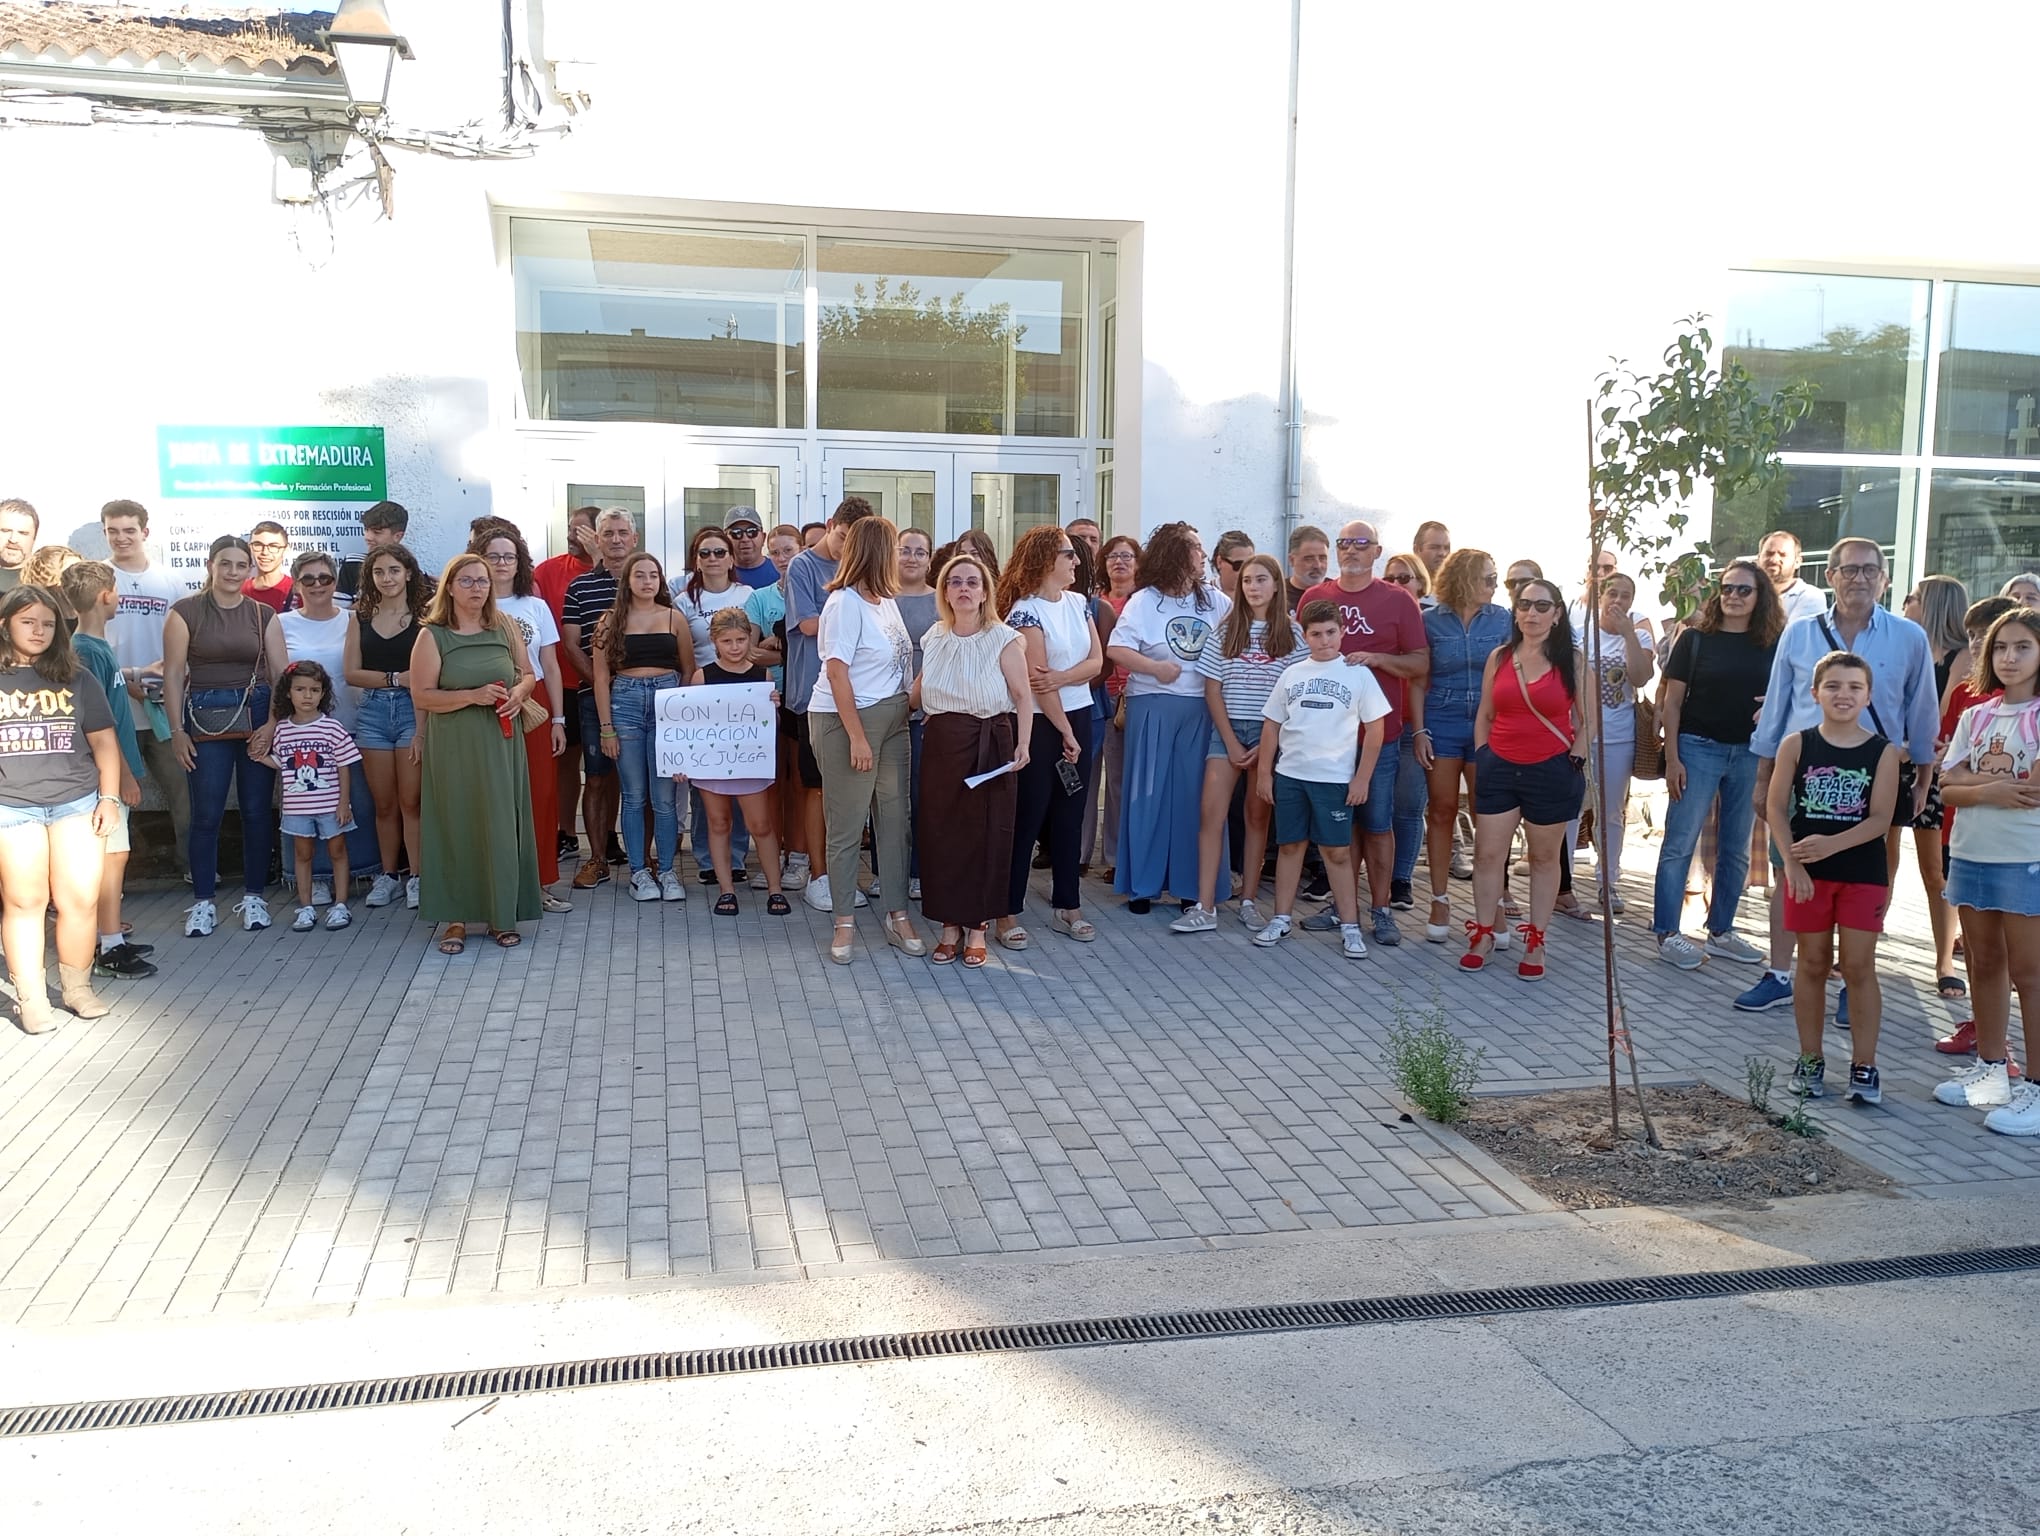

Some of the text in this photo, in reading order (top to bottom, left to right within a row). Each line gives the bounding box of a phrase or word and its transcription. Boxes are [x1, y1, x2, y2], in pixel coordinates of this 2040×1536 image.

[168, 442, 221, 468] JTA
[259, 443, 374, 467] EXTREMADURA
[289, 484, 295, 493] y
[295, 483, 332, 491] Formación
[333, 483, 372, 492] Profesional
[294, 510, 310, 520] POR
[312, 507, 352, 521] RESCISIÓN
[285, 526, 334, 538] CESIBILIDAD,
[170, 541, 211, 552] DE CARPIN
[317, 542, 328, 552] EN
[330, 542, 341, 552] EL
[171, 557, 183, 568] IES
[185, 557, 201, 568] SAN
[1284, 681, 1306, 706] LOS
[664, 694, 756, 722] CON LA
[0, 740, 47, 752] TOUR
[662, 751, 684, 766] NO
[714, 750, 768, 766] JUEGA
[1805, 775, 1866, 795] BEACH
